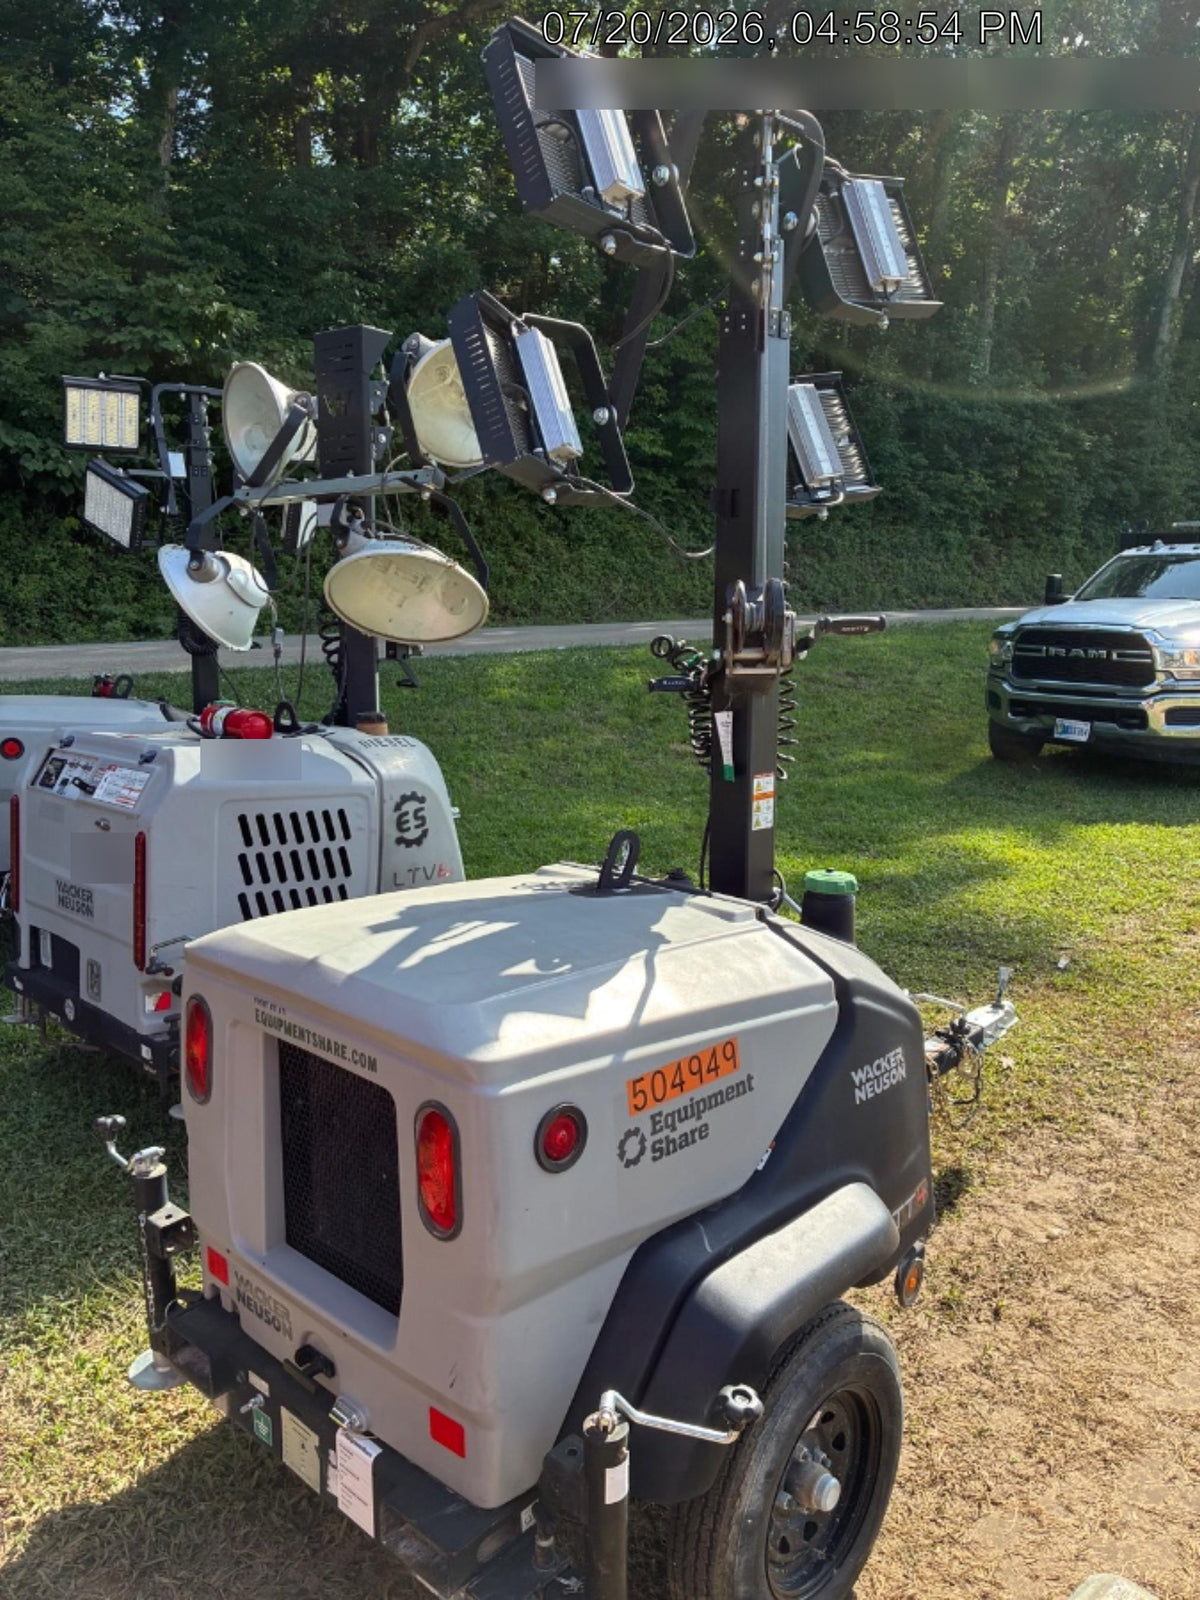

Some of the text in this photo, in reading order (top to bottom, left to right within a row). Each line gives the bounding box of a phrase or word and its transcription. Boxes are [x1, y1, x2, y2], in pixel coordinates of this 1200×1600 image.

[1048, 646, 1107, 659] RAM
[254, 1008, 378, 1073] EQUIPMENTSHARE.COM
[631, 1040, 738, 1112] 504949
[850, 1046, 904, 1087] WACKER
[854, 1065, 907, 1105] NEUSON
[649, 1073, 755, 1137] Equipment
[650, 1122, 710, 1163] Share
[236, 1286, 293, 1341] NEUSON
